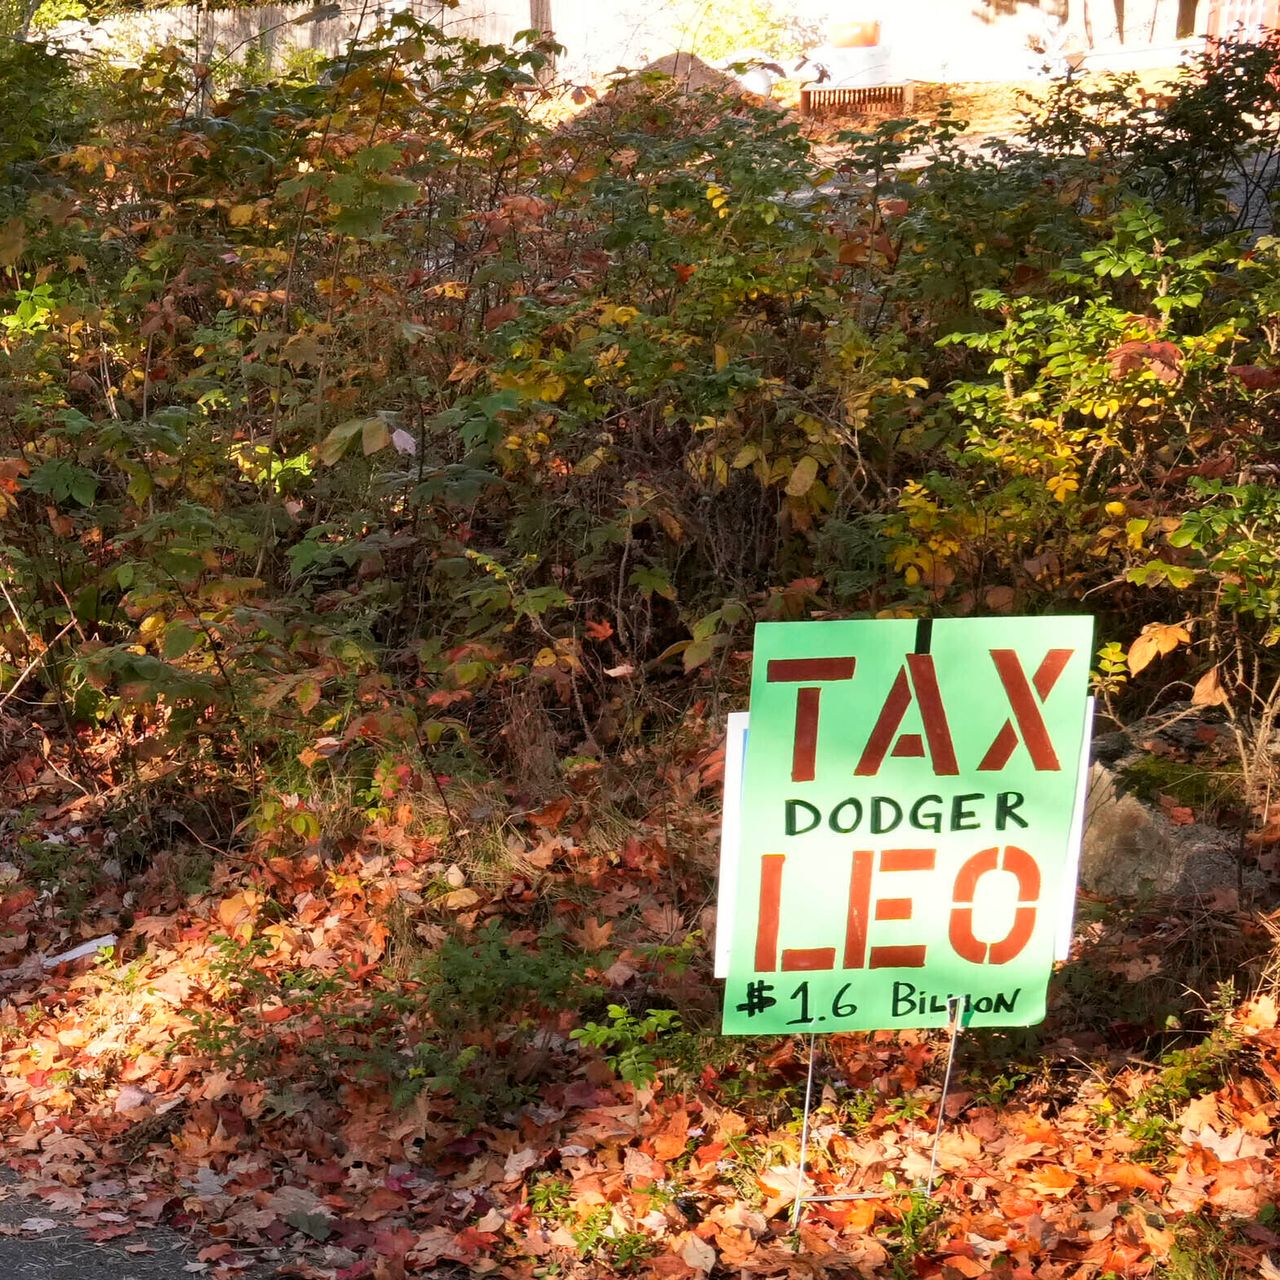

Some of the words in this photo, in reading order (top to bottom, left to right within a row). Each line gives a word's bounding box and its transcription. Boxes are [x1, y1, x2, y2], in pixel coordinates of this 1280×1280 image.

[766, 648, 1076, 783] TAX
[784, 791, 1030, 836] DODGER
[753, 845, 1042, 973] LEO
